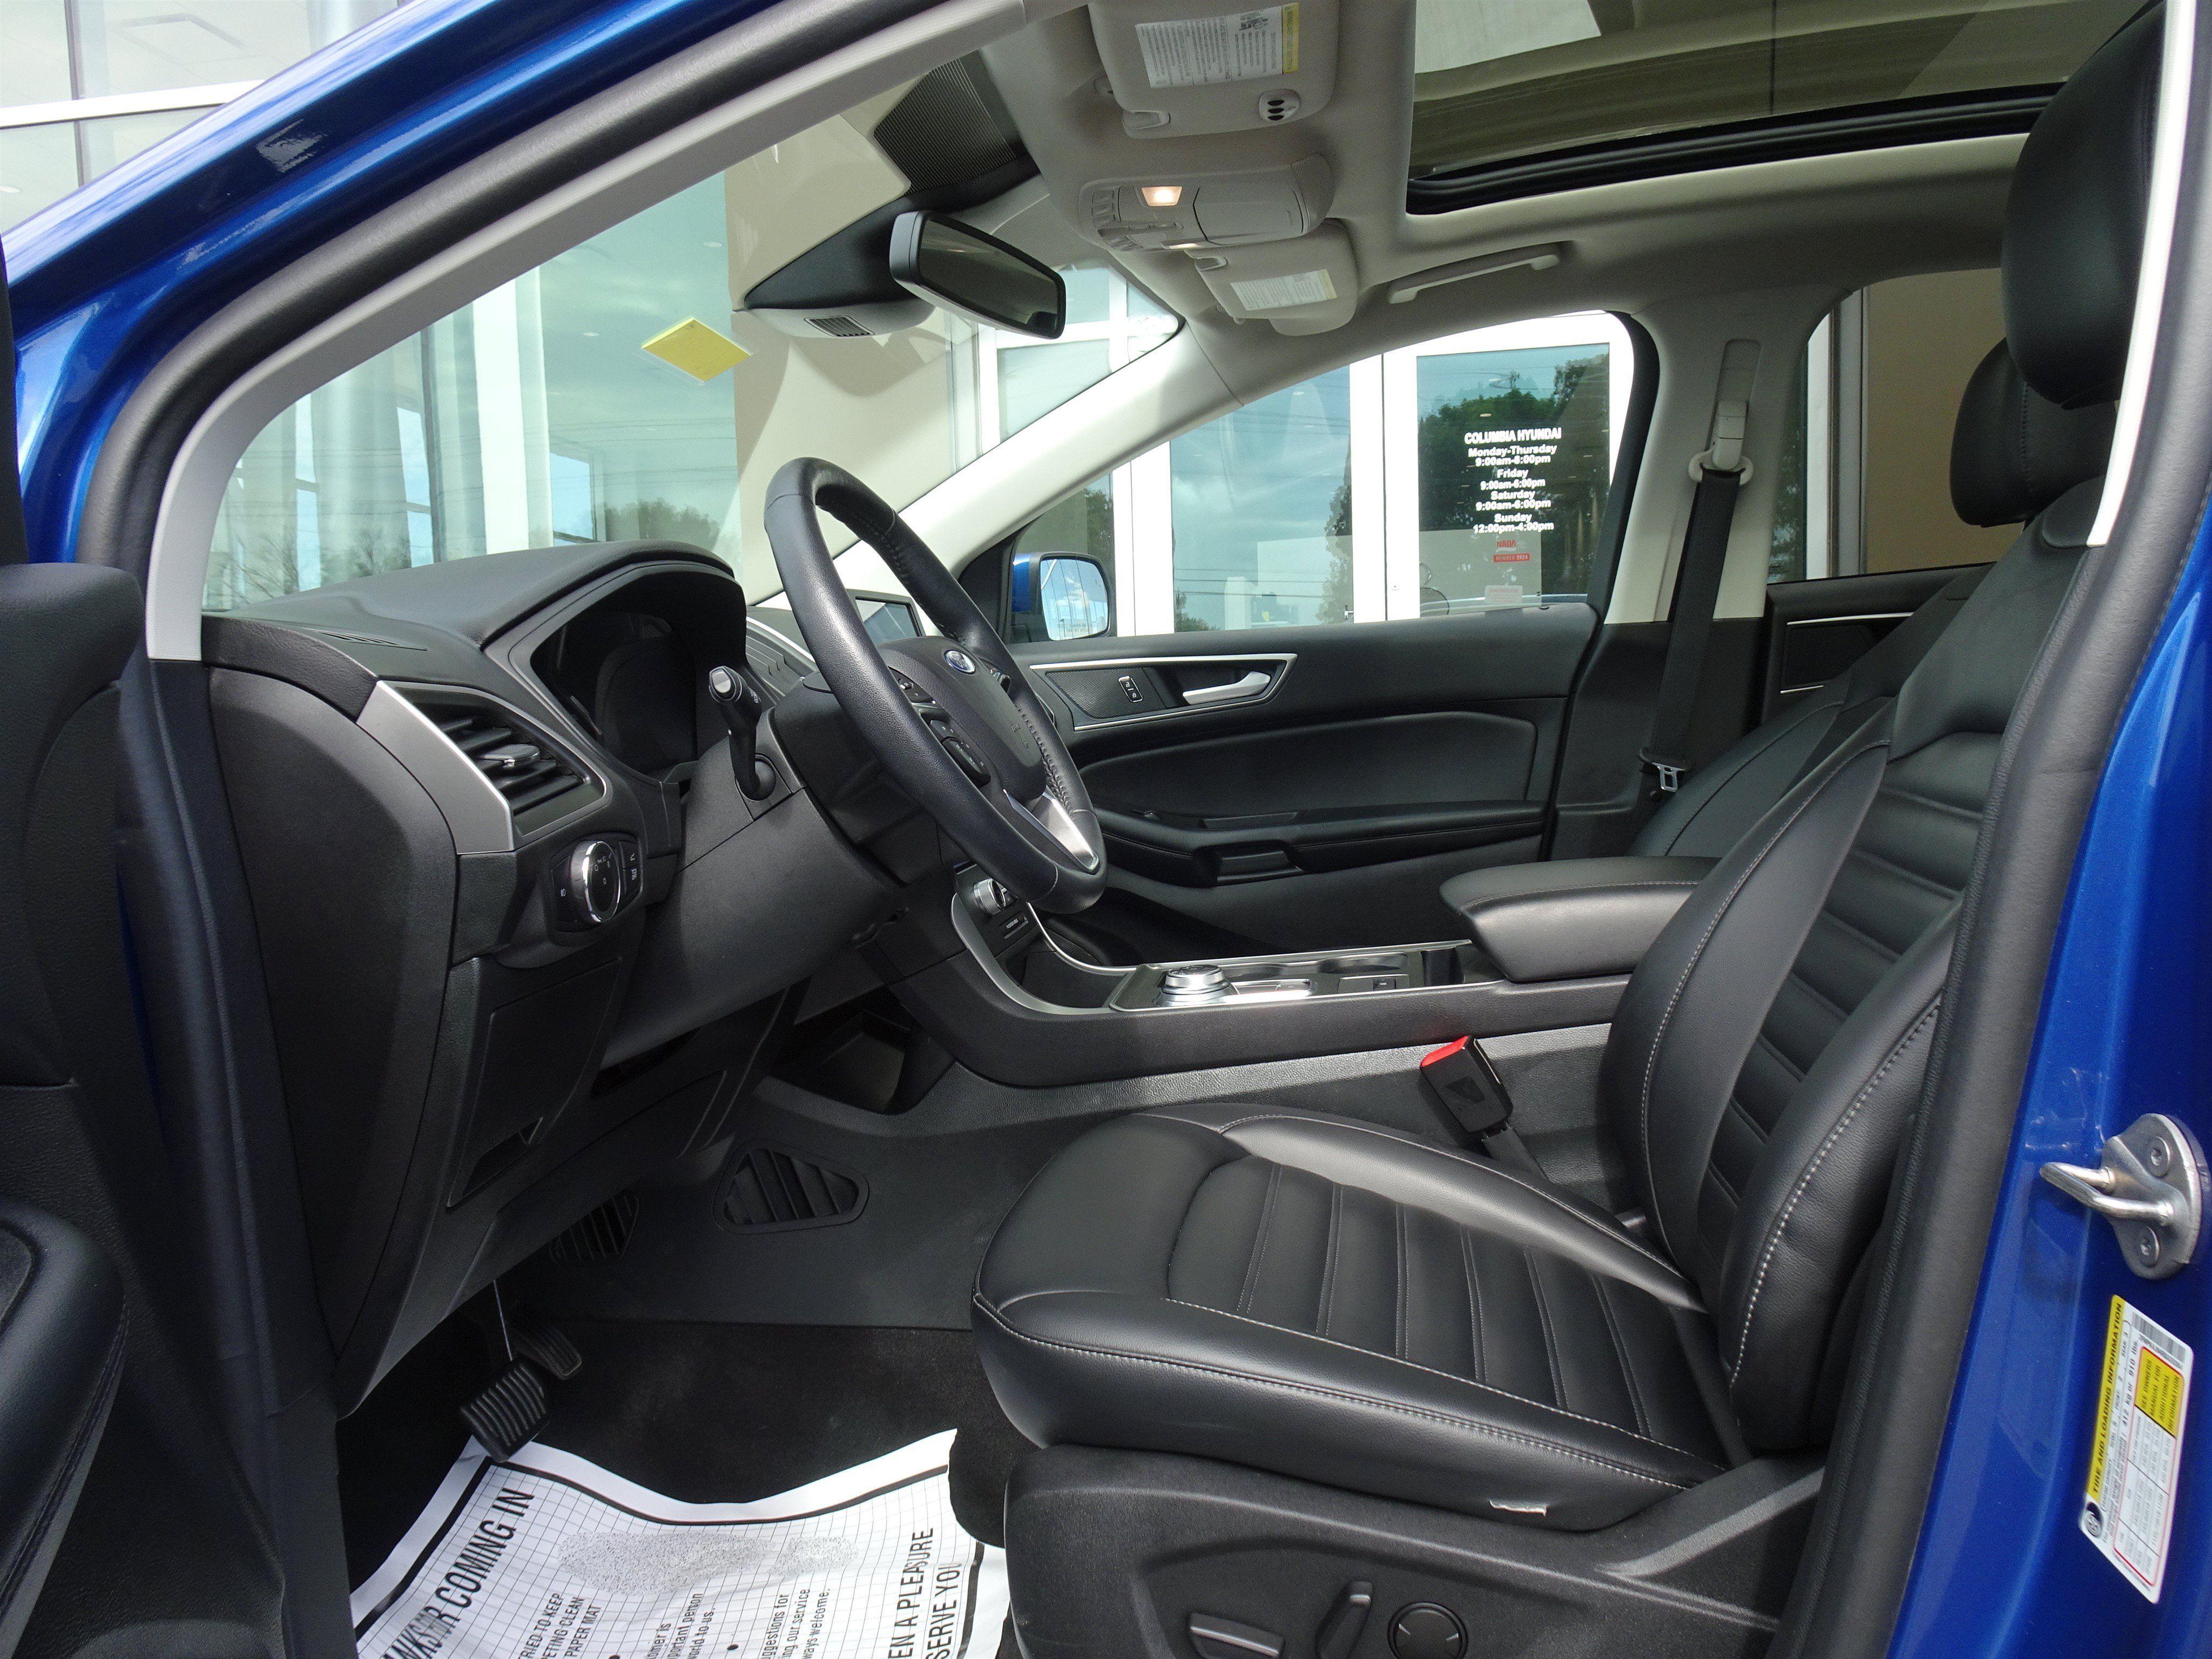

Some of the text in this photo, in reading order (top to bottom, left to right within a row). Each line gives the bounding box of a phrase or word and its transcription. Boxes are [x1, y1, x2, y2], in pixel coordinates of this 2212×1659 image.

[1464, 427, 1562, 444] COLUMBIA HYUNDAI
[1468, 444, 1557, 457] Monday-Thursday
[1497, 468, 1529, 478] Friday
[1491, 490, 1535, 500] Saturday
[1473, 522, 1554, 534] 12:00pm-4:00pm
[1494, 512, 1532, 523] Sunday
[2093, 1303, 2122, 1493] TIRE AND LOADING INFORMATION
[383, 1623, 442, 1659] NKS
[436, 1520, 517, 1608] COMING
[492, 1488, 535, 1517] IN
[896, 1528, 933, 1610] PLEASURE
[559, 1596, 585, 1626] CLEAN
[682, 1594, 703, 1623] person
[774, 1594, 790, 1608] for
[792, 1589, 811, 1623] service
[810, 1588, 830, 1636] welcome.
[518, 1593, 564, 1659] RIED TO KEEP
[564, 1604, 602, 1657] PAPER MAT
[656, 1623, 671, 1631] is
[695, 1626, 709, 1636] to
[702, 1608, 716, 1623] us.
[894, 1615, 919, 1627] A
[787, 1626, 800, 1642] our
